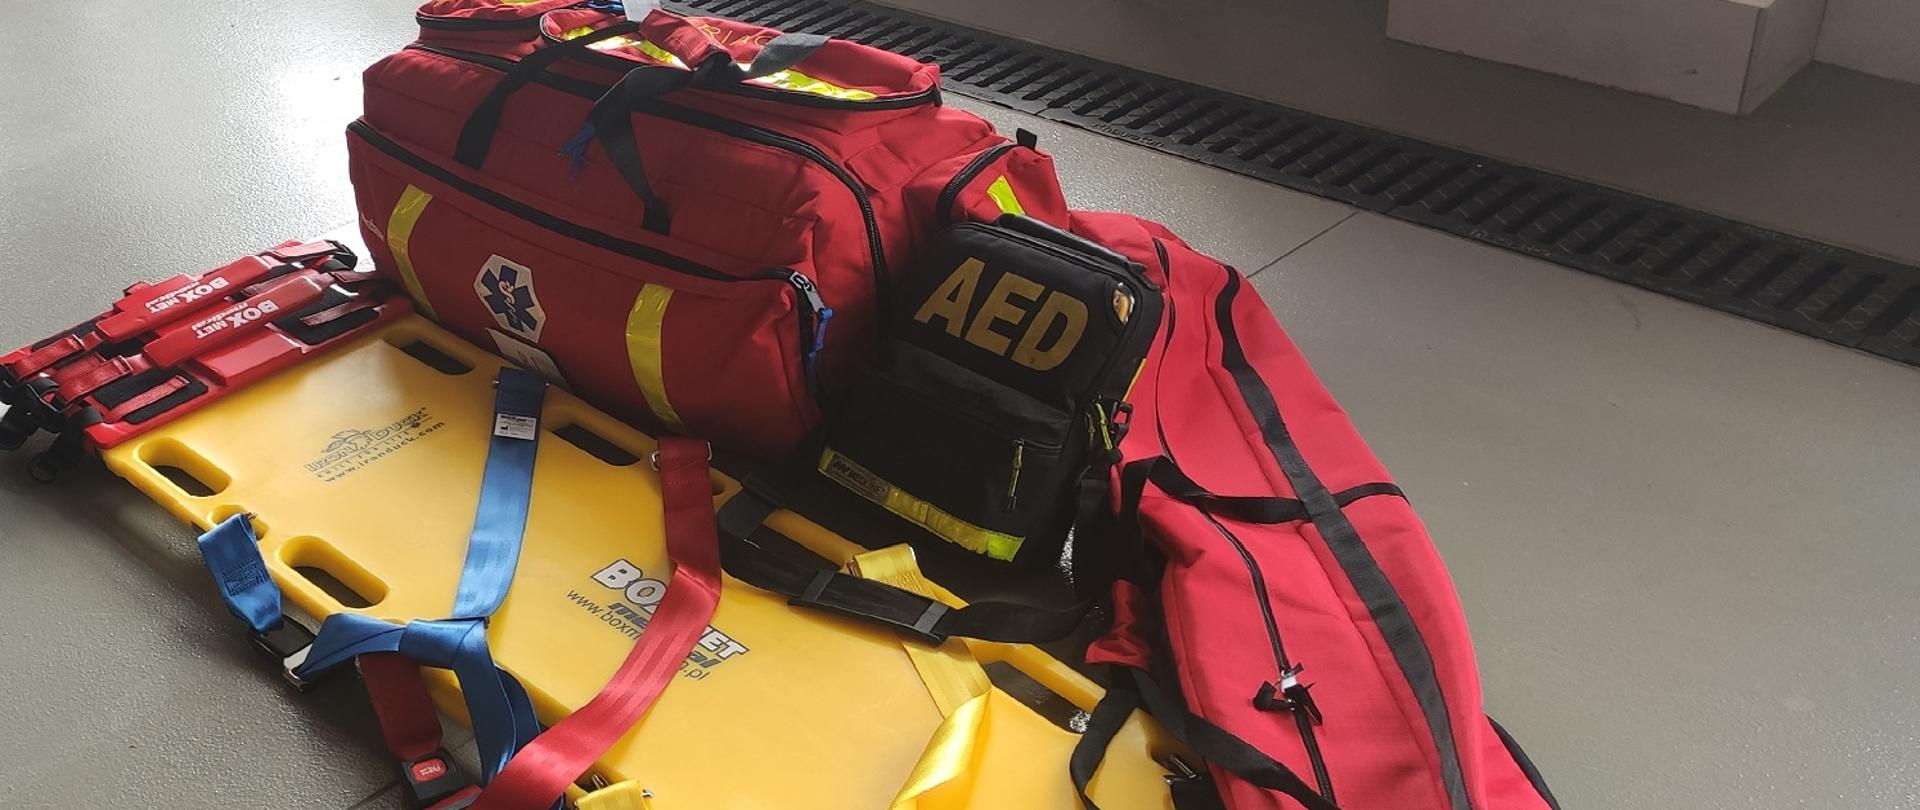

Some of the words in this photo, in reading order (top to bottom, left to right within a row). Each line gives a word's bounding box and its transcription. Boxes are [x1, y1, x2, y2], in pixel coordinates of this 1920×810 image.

[177, 276, 230, 303] BOX
[149, 296, 180, 313] MET
[224, 299, 279, 328] BOX
[913, 256, 1089, 371] AED
[196, 319, 228, 339] MET
[325, 421, 445, 482] www.ironduck.com
[697, 624, 750, 660] ET
